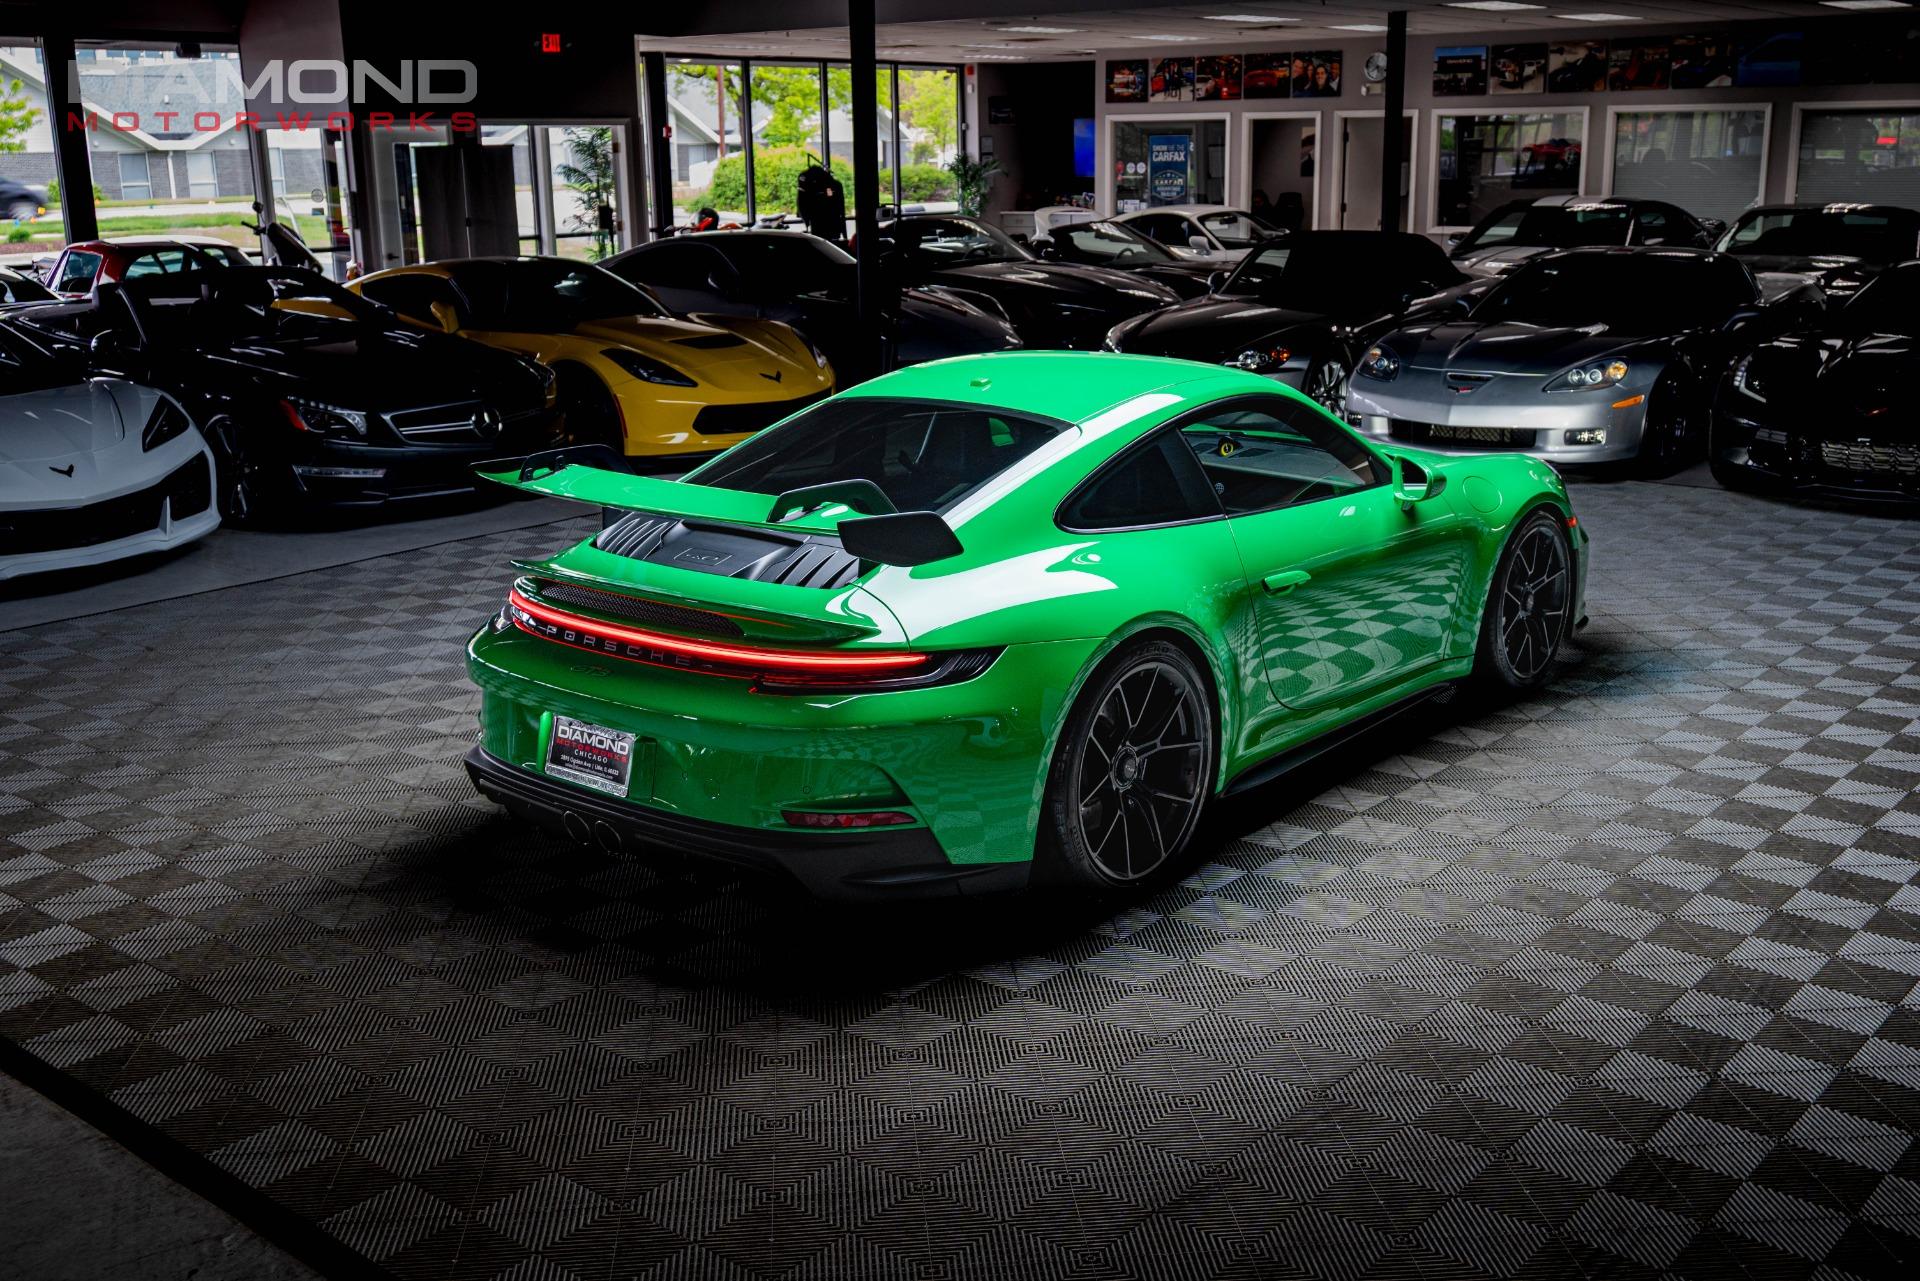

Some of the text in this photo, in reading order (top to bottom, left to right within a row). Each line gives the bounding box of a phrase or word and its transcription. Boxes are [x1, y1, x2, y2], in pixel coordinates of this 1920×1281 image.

[542, 34, 561, 53] EXIT
[1152, 151, 1186, 162] CARFAX
[545, 625, 692, 667] PORSCHE
[556, 737, 628, 763] MOTORWORKS
[558, 725, 629, 755] DIAMOND
[574, 750, 608, 763] CHICAGO
